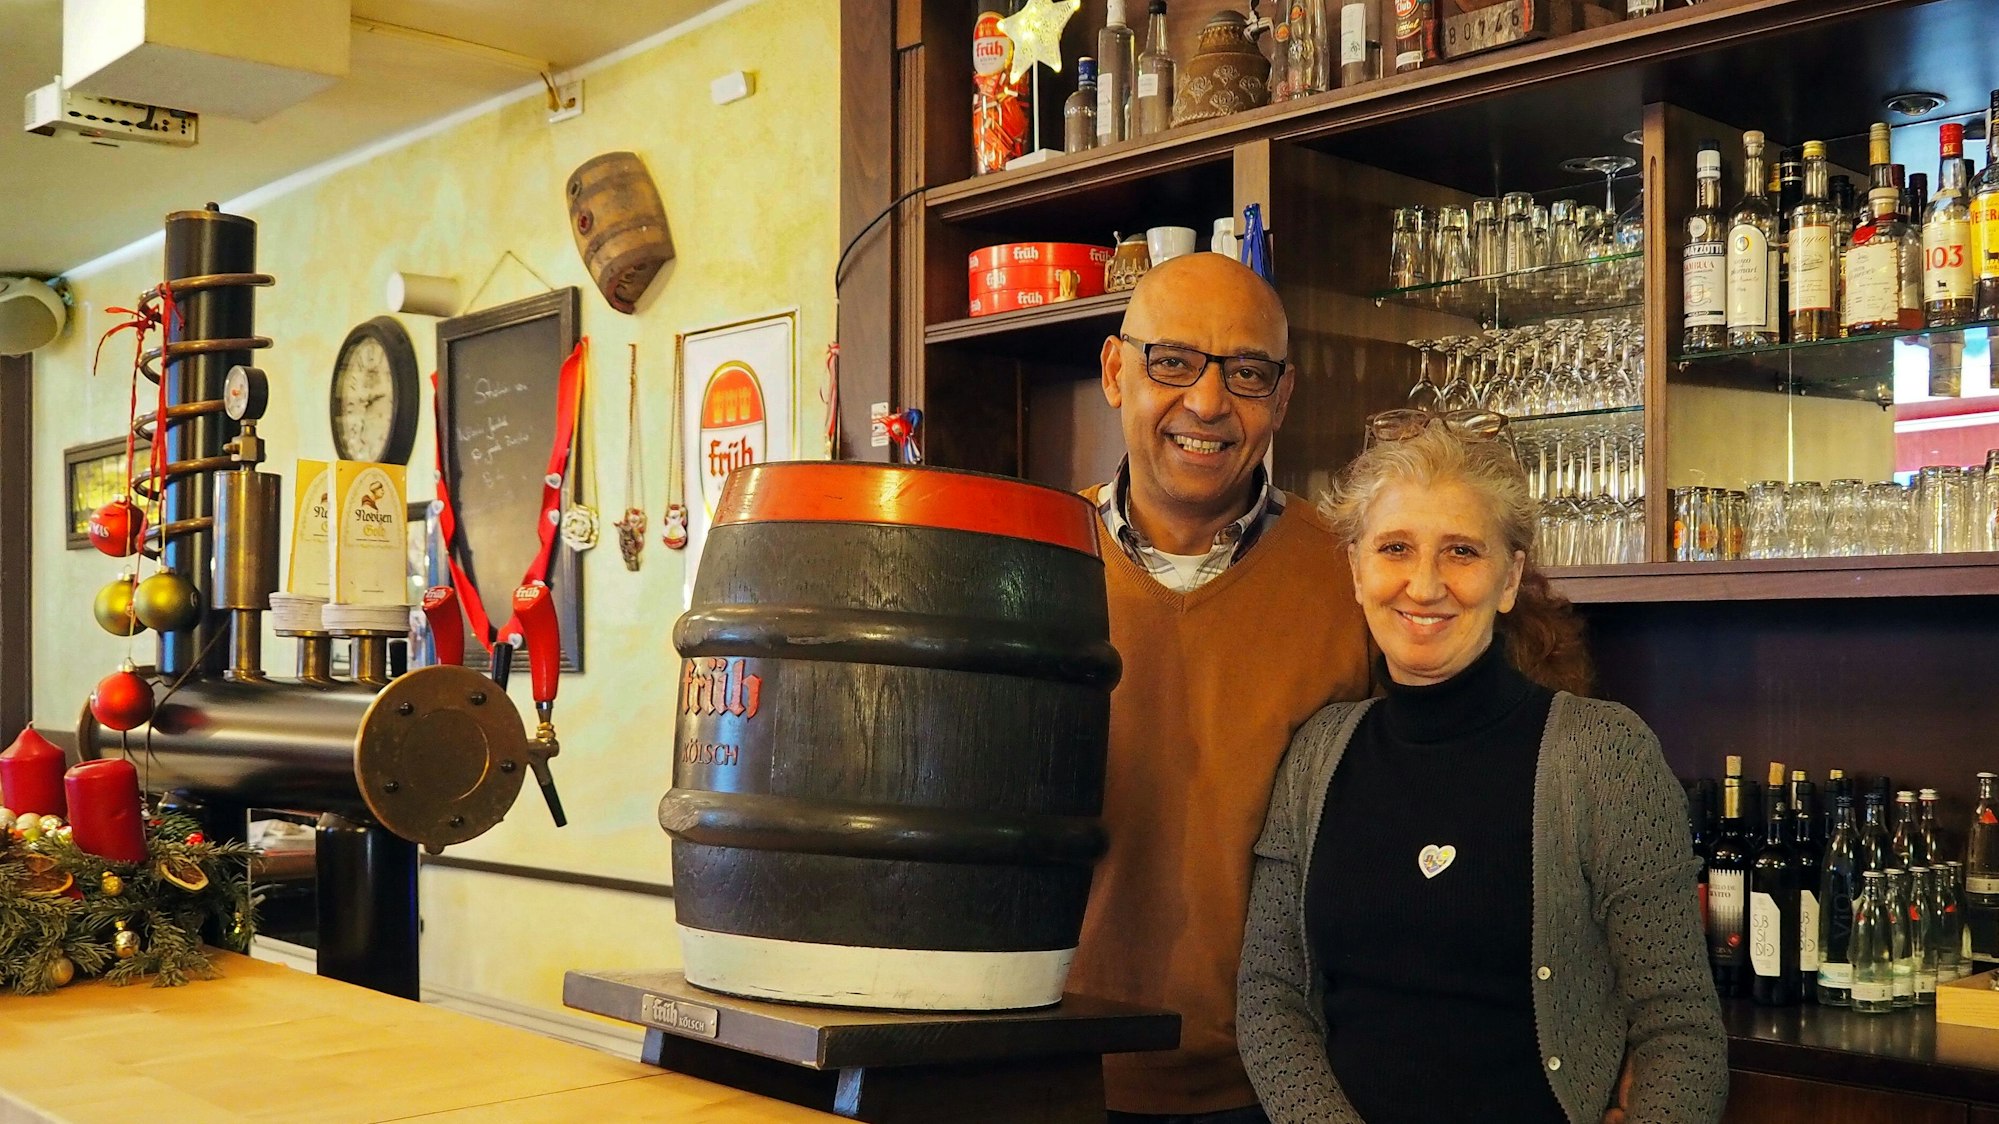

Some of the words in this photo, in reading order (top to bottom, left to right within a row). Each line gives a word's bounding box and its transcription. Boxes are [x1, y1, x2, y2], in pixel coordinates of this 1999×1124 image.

[976, 40, 1004, 58] früh
[1970, 207, 1999, 226] VETER
[1013, 246, 1039, 260] früh
[1925, 244, 1965, 272] 103
[1017, 291, 1043, 305] früh
[708, 435, 753, 476] früh
[682, 658, 763, 722] früh
[682, 739, 740, 766] KÖLSCH
[653, 998, 678, 1027] früh
[679, 1014, 705, 1032] KÖLSCH
